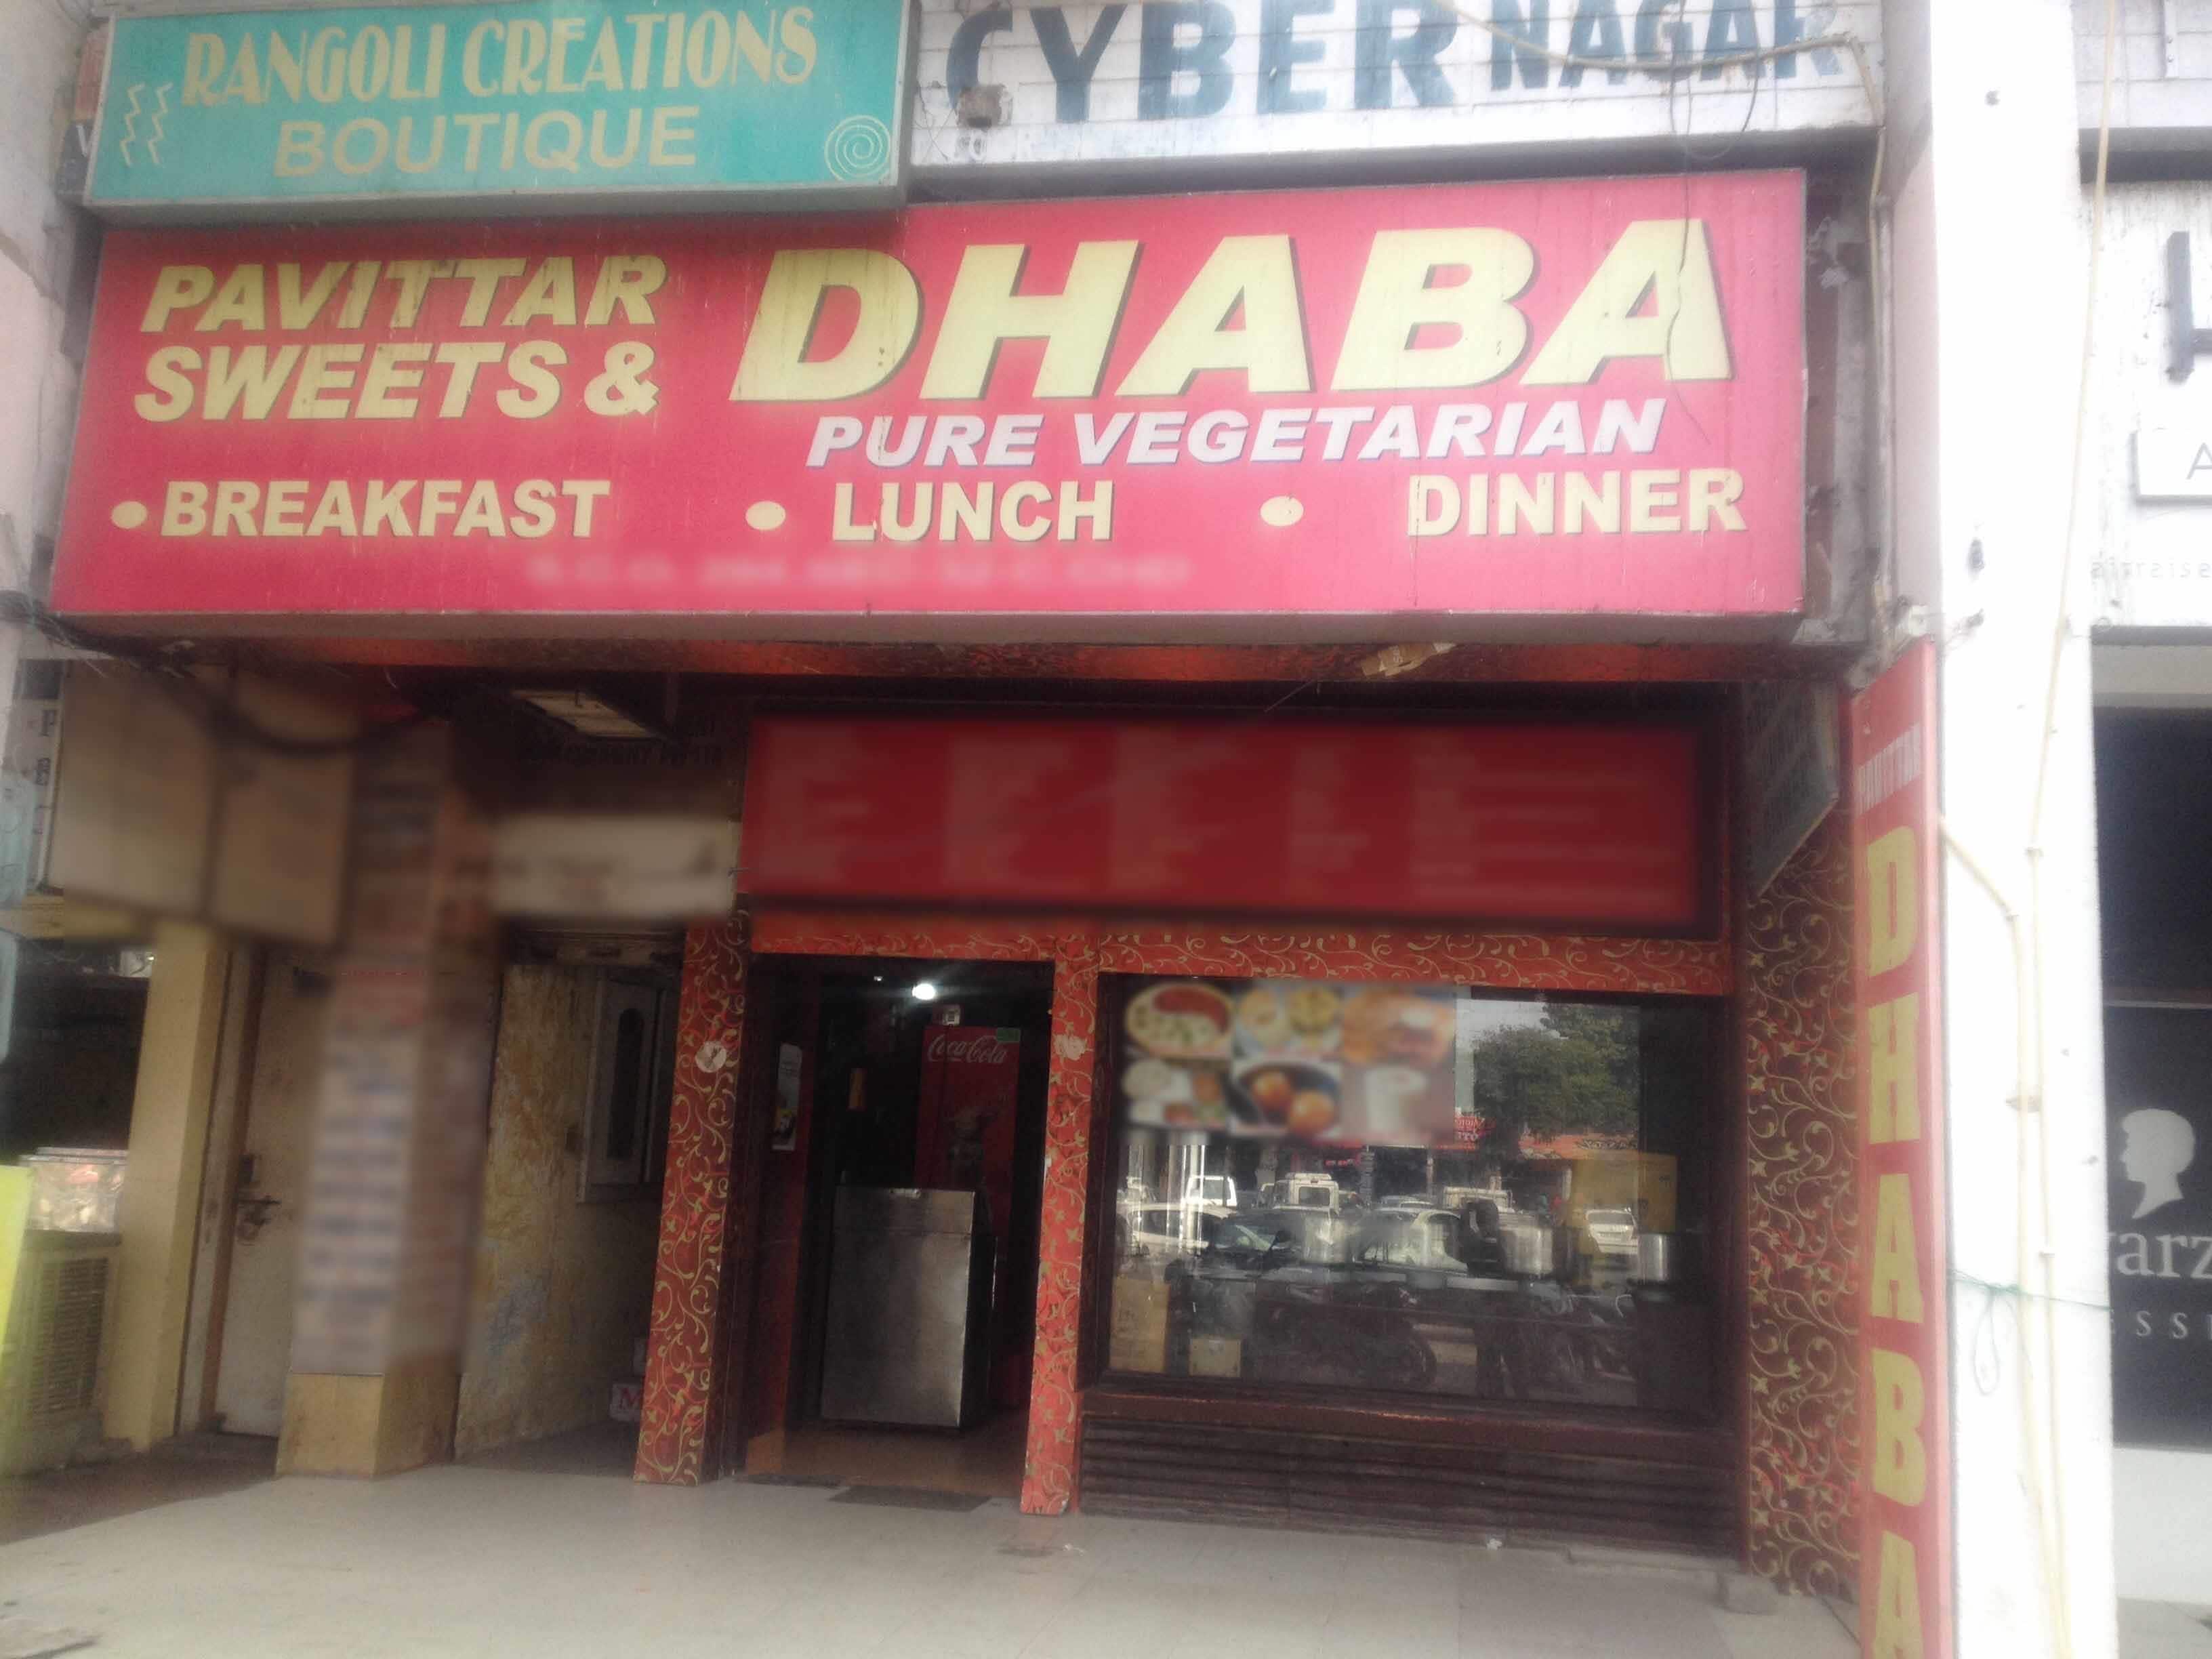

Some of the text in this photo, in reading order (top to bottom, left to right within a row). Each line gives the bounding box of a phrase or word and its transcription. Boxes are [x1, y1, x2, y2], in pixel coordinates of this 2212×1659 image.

[182, 7, 817, 106] RANGOLI CREATIONS
[274, 105, 700, 178] BOUTIQUE
[140, 254, 668, 332] PAVITTAR
[728, 218, 1734, 402] DHABA
[135, 340, 660, 423] SWEETS &
[806, 398, 1666, 468] PURE VEGETARIAN
[161, 479, 613, 538] BREAKFAST
[832, 480, 1115, 541] LUNCH
[1407, 468, 1748, 536] DINNER
[1866, 825, 1927, 1659] DHABA
[2108, 1231, 2212, 1279] arz
